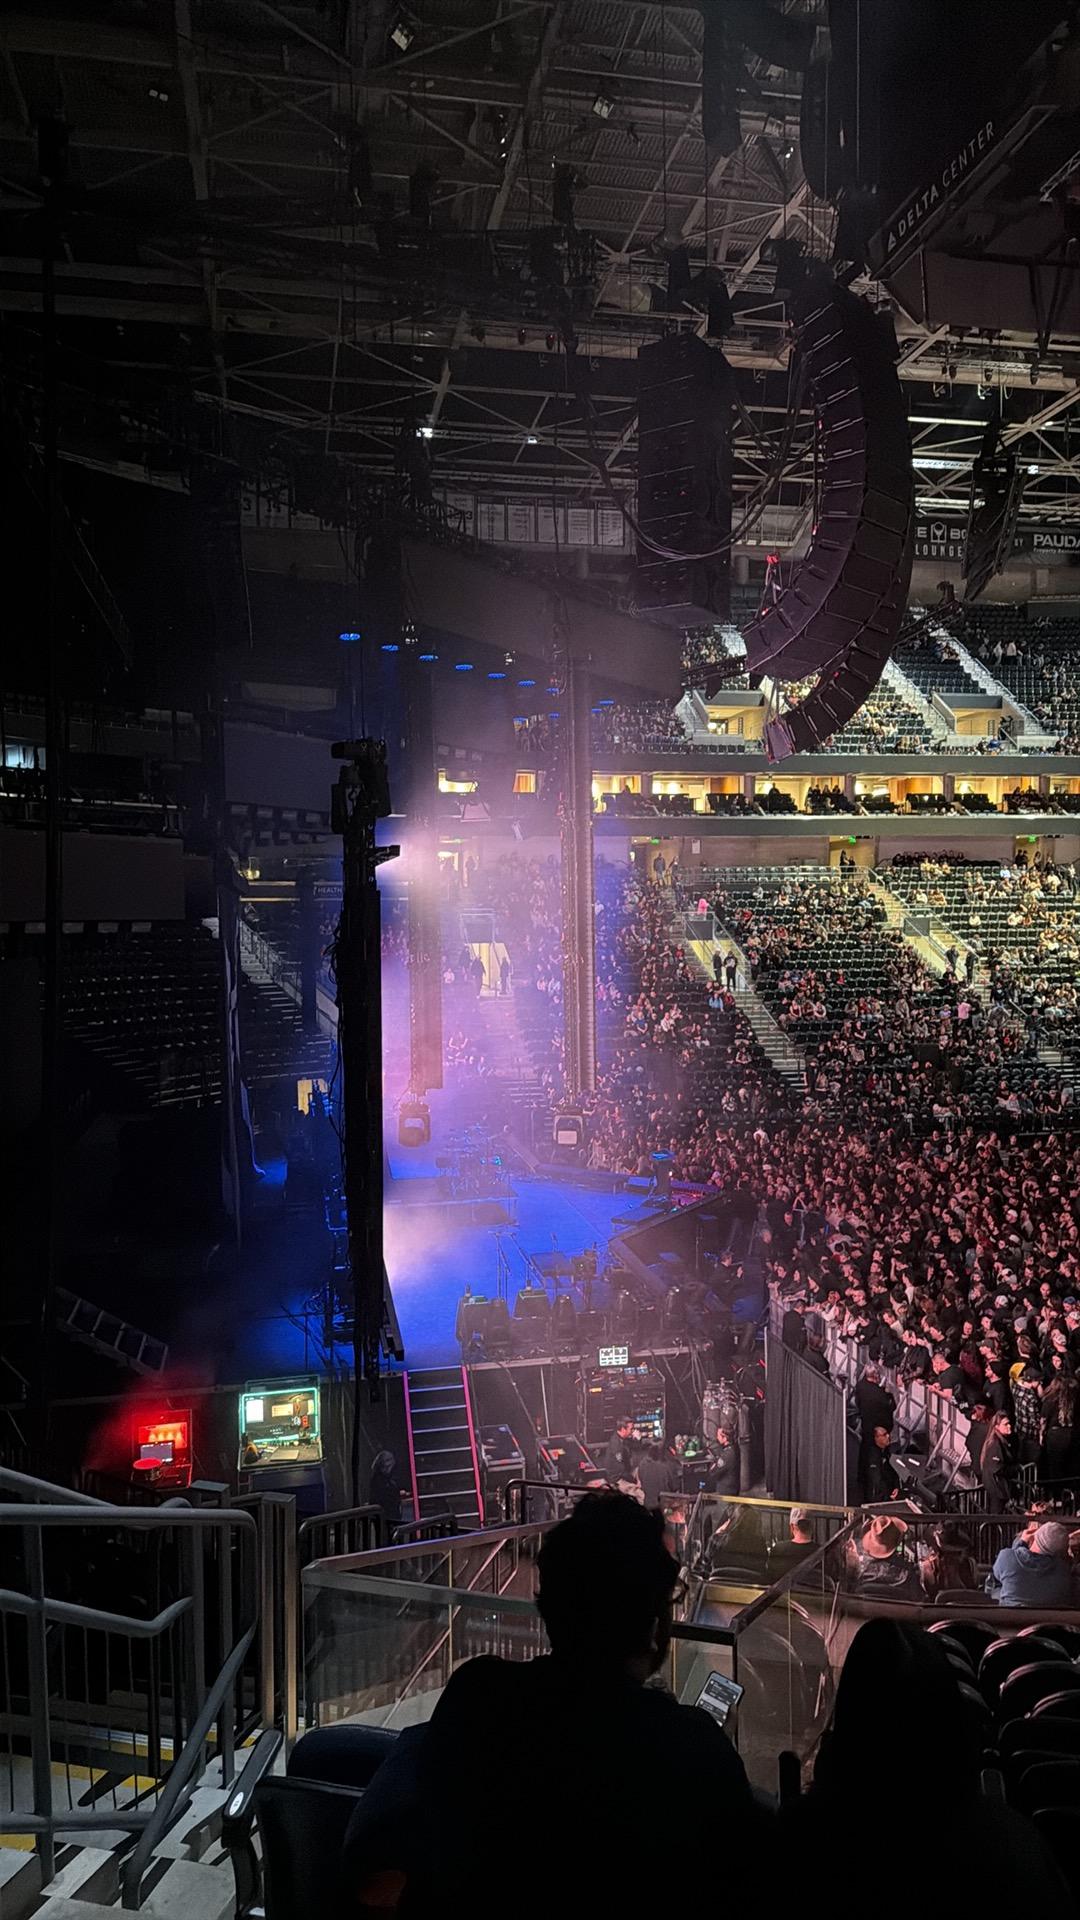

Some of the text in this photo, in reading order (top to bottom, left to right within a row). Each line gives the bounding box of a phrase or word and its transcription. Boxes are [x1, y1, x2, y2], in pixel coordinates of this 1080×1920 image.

[899, 121, 995, 237] DELTA CENTER
[915, 543, 962, 557] LOUNGE
